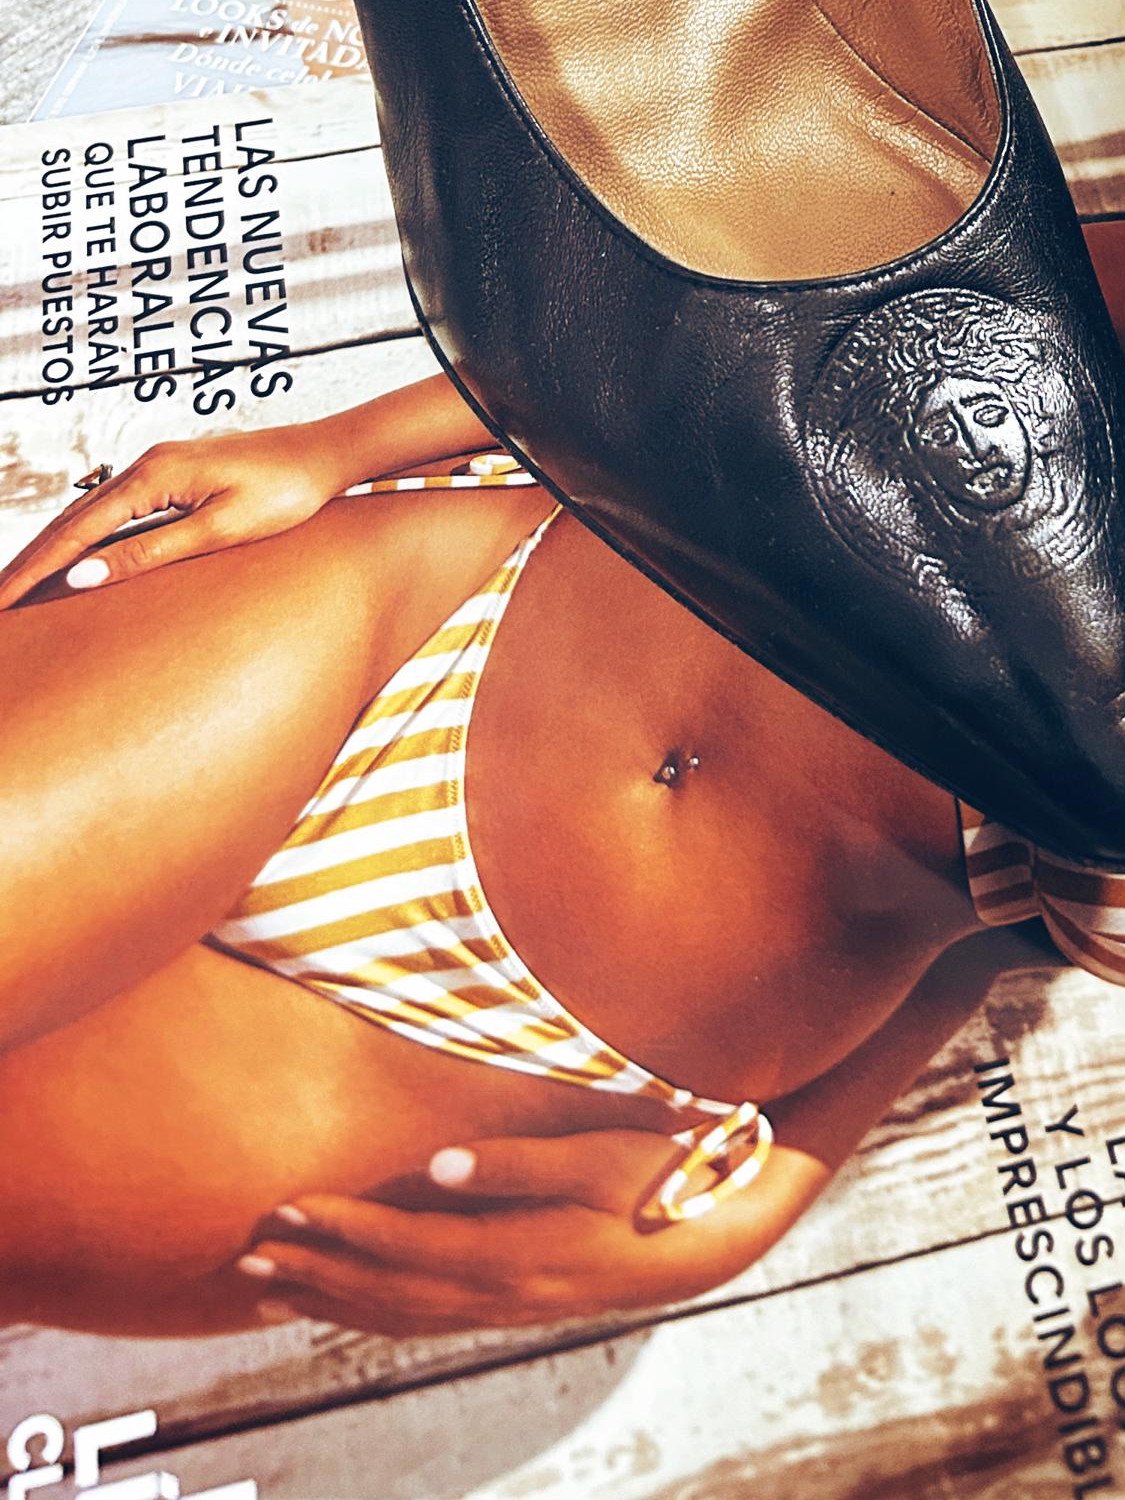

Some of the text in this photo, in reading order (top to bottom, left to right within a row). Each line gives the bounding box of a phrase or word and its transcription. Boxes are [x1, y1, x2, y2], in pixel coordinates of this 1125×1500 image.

[168, 43, 261, 76] Dónde
[216, 23, 370, 70] INVITAD
[291, 17, 319, 34] de
[42, 149, 74, 405] SUBIR PUESTOS
[82, 142, 128, 391] QUE TE HARÁN
[127, 135, 176, 402] LABORALES
[181, 125, 235, 415] TENDENCIAS
[234, 117, 293, 398] LAS NUEVAS
[1045, 1104, 1084, 1138] Y
[1055, 1157, 1114, 1266] LOS
